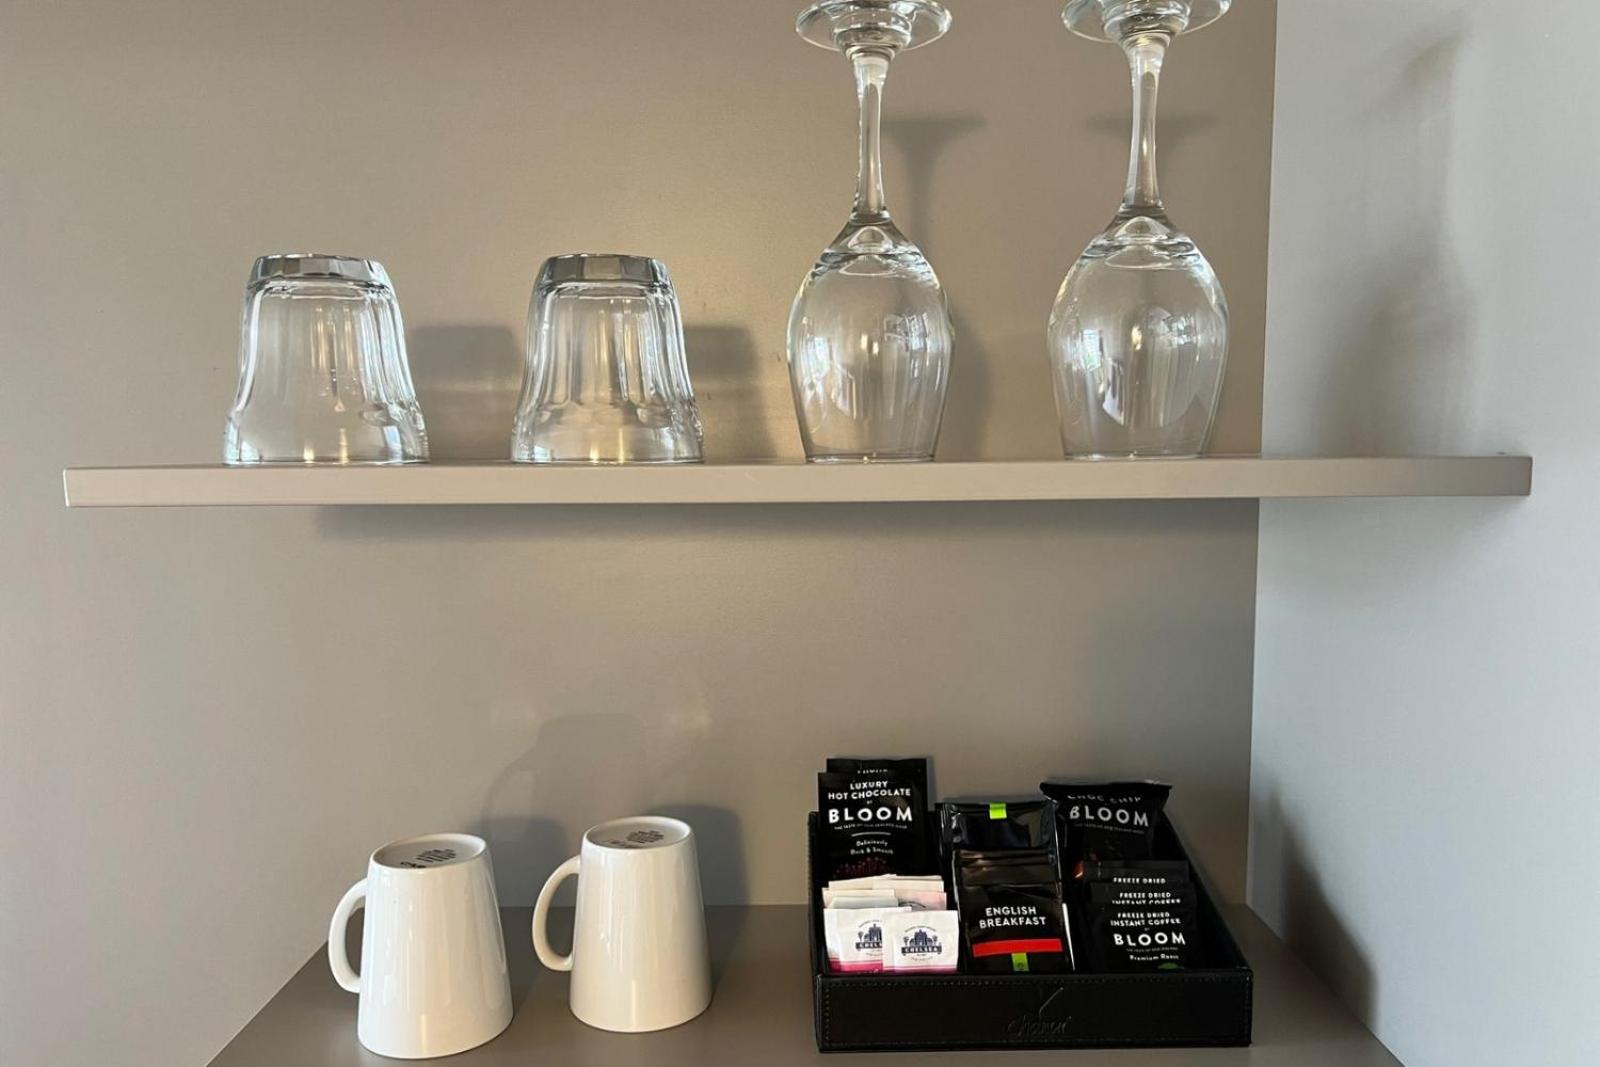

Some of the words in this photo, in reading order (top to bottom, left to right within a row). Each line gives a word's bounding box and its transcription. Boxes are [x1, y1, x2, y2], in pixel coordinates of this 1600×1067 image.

[850, 781, 888, 790] LUXURY
[828, 792, 849, 800] HOT
[851, 788, 911, 800] CHOCOLATE
[829, 806, 912, 824] BLOOM
[1069, 805, 1149, 827] BLOOM
[985, 906, 1037, 916] ENGLISH
[979, 916, 1046, 928] BREAKFAST
[1110, 919, 1145, 927] INSTANT
[1148, 918, 1181, 926] COFFEE
[1113, 931, 1186, 947] BLOOM
